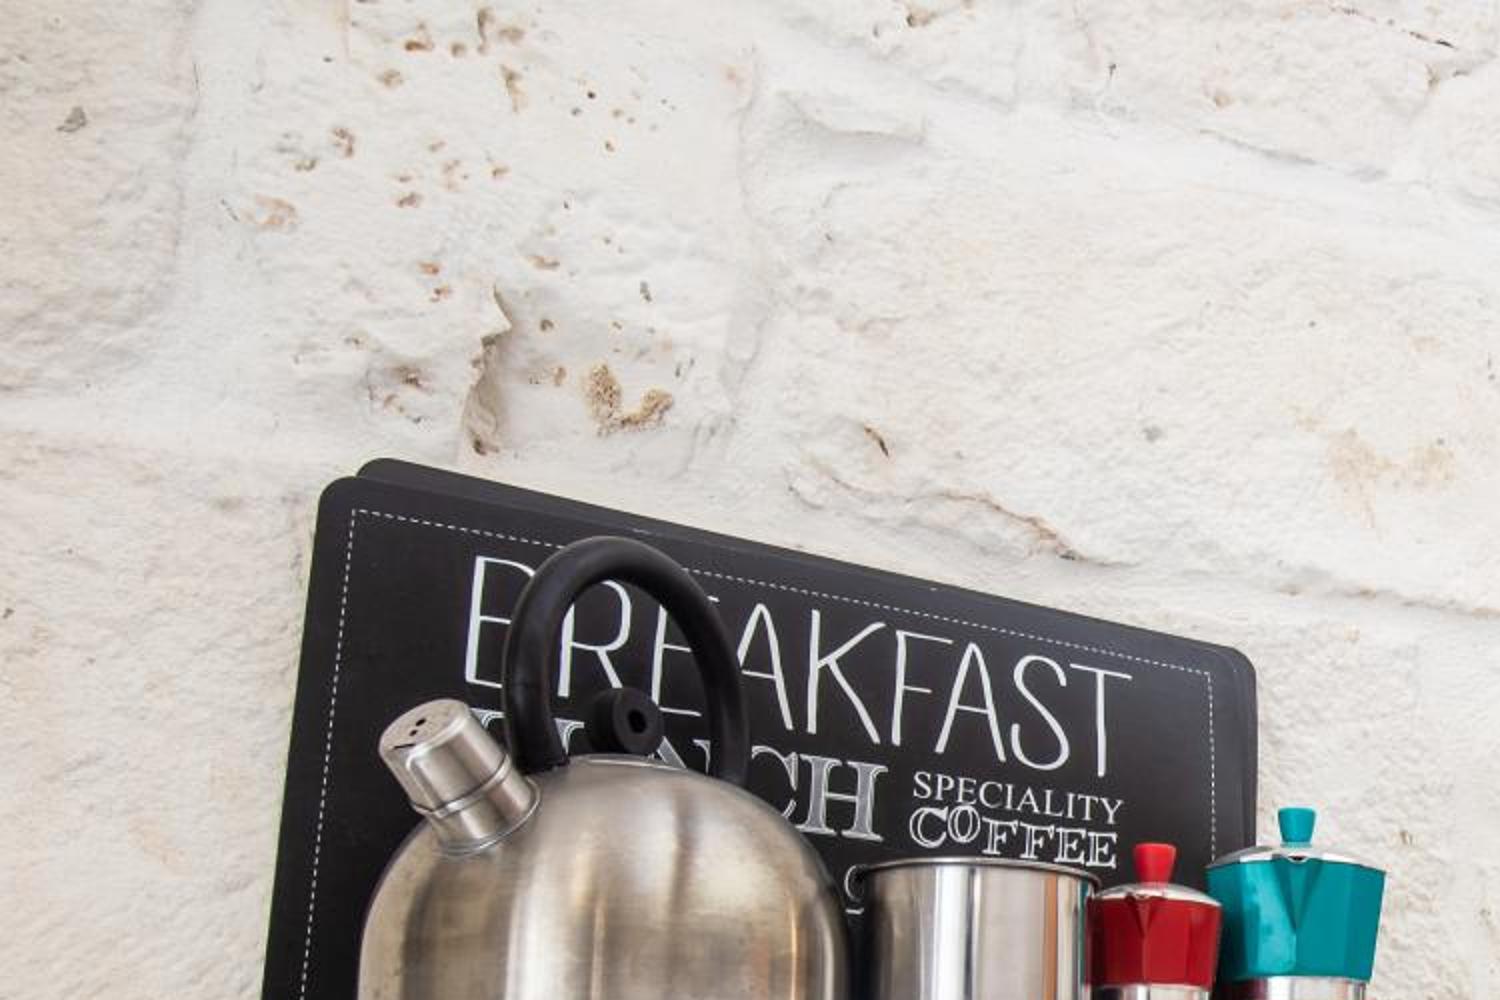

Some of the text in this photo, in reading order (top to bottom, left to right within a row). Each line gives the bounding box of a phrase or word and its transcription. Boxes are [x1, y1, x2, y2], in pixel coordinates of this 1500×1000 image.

[464, 555, 1132, 777] BREAKFAST
[913, 770, 1125, 826] SPECIALITY
[909, 804, 1119, 870] COFFEE
